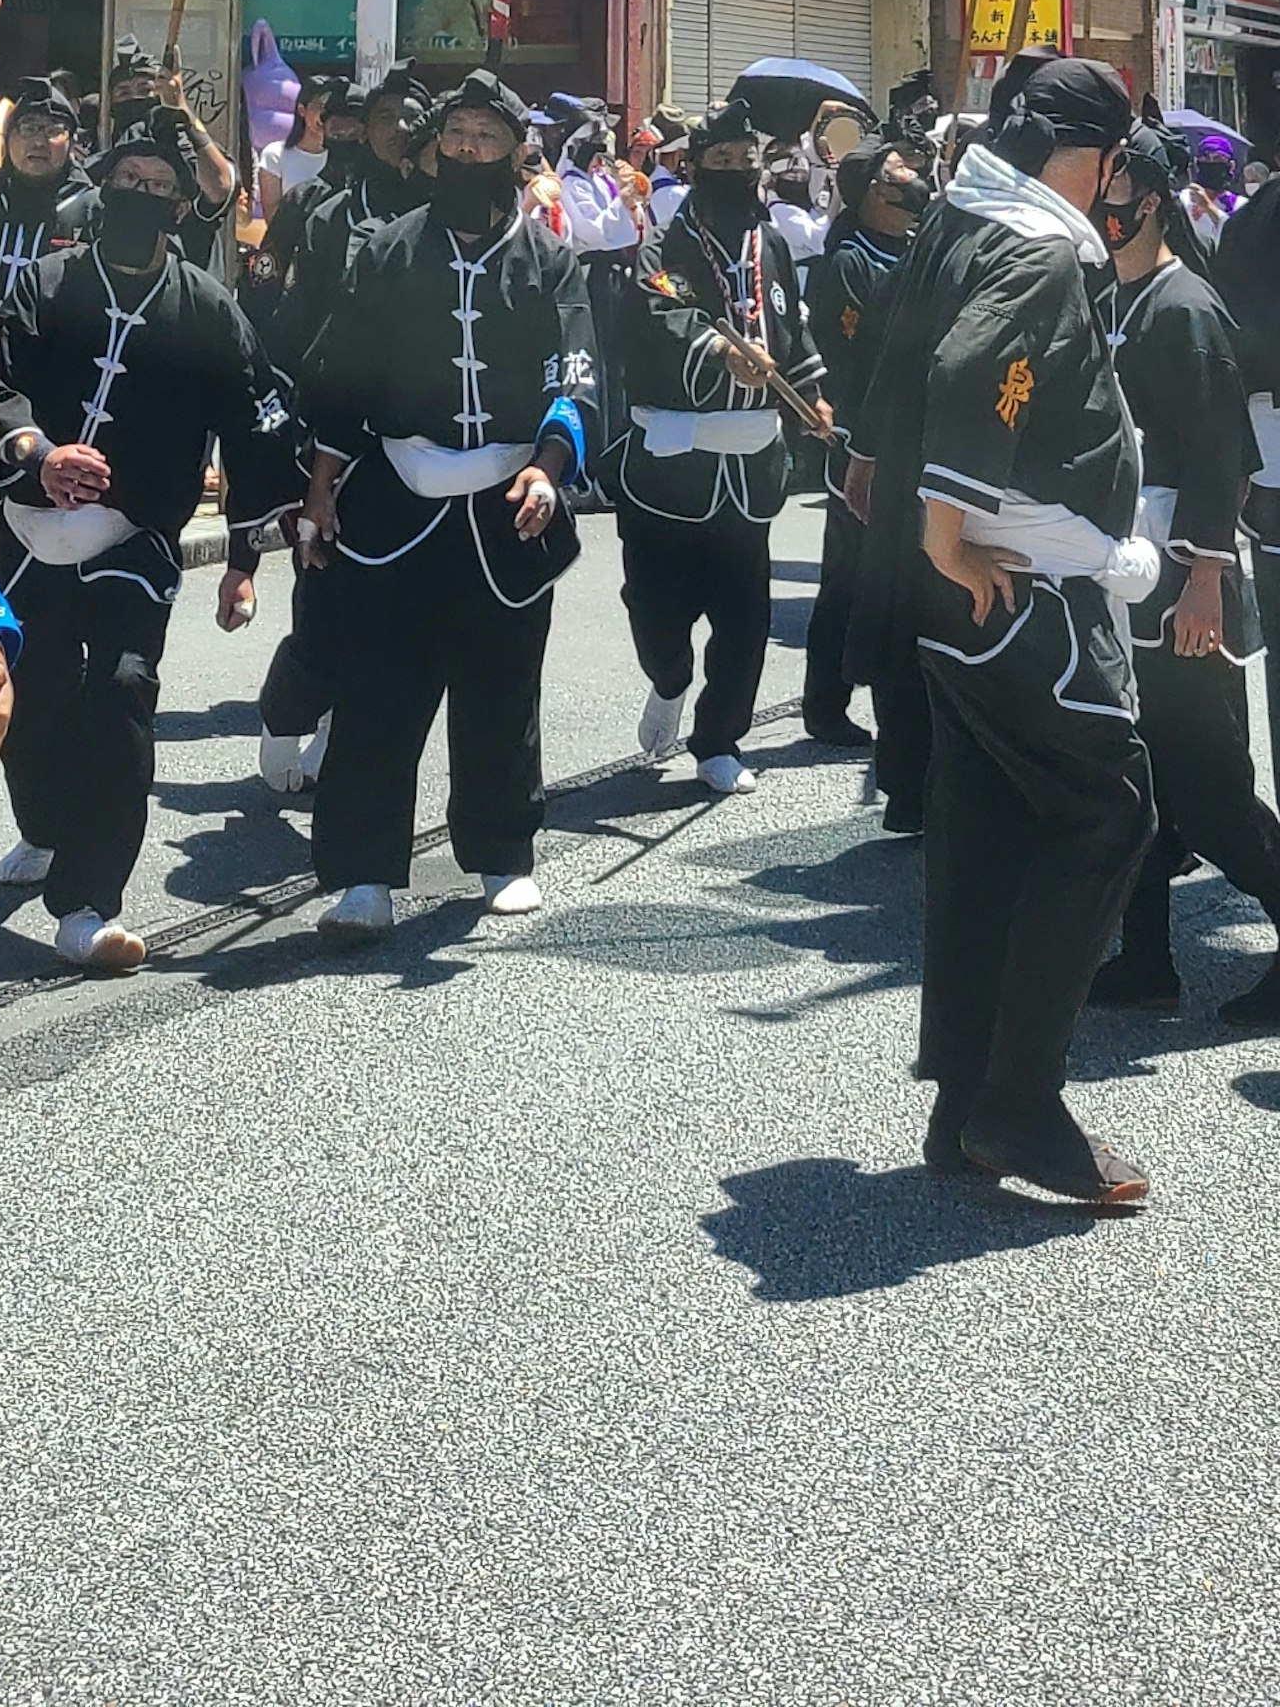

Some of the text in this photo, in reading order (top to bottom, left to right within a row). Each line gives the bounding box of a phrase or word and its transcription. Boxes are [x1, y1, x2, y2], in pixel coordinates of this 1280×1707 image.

[970, 29, 1058, 43] ちんす本舗
